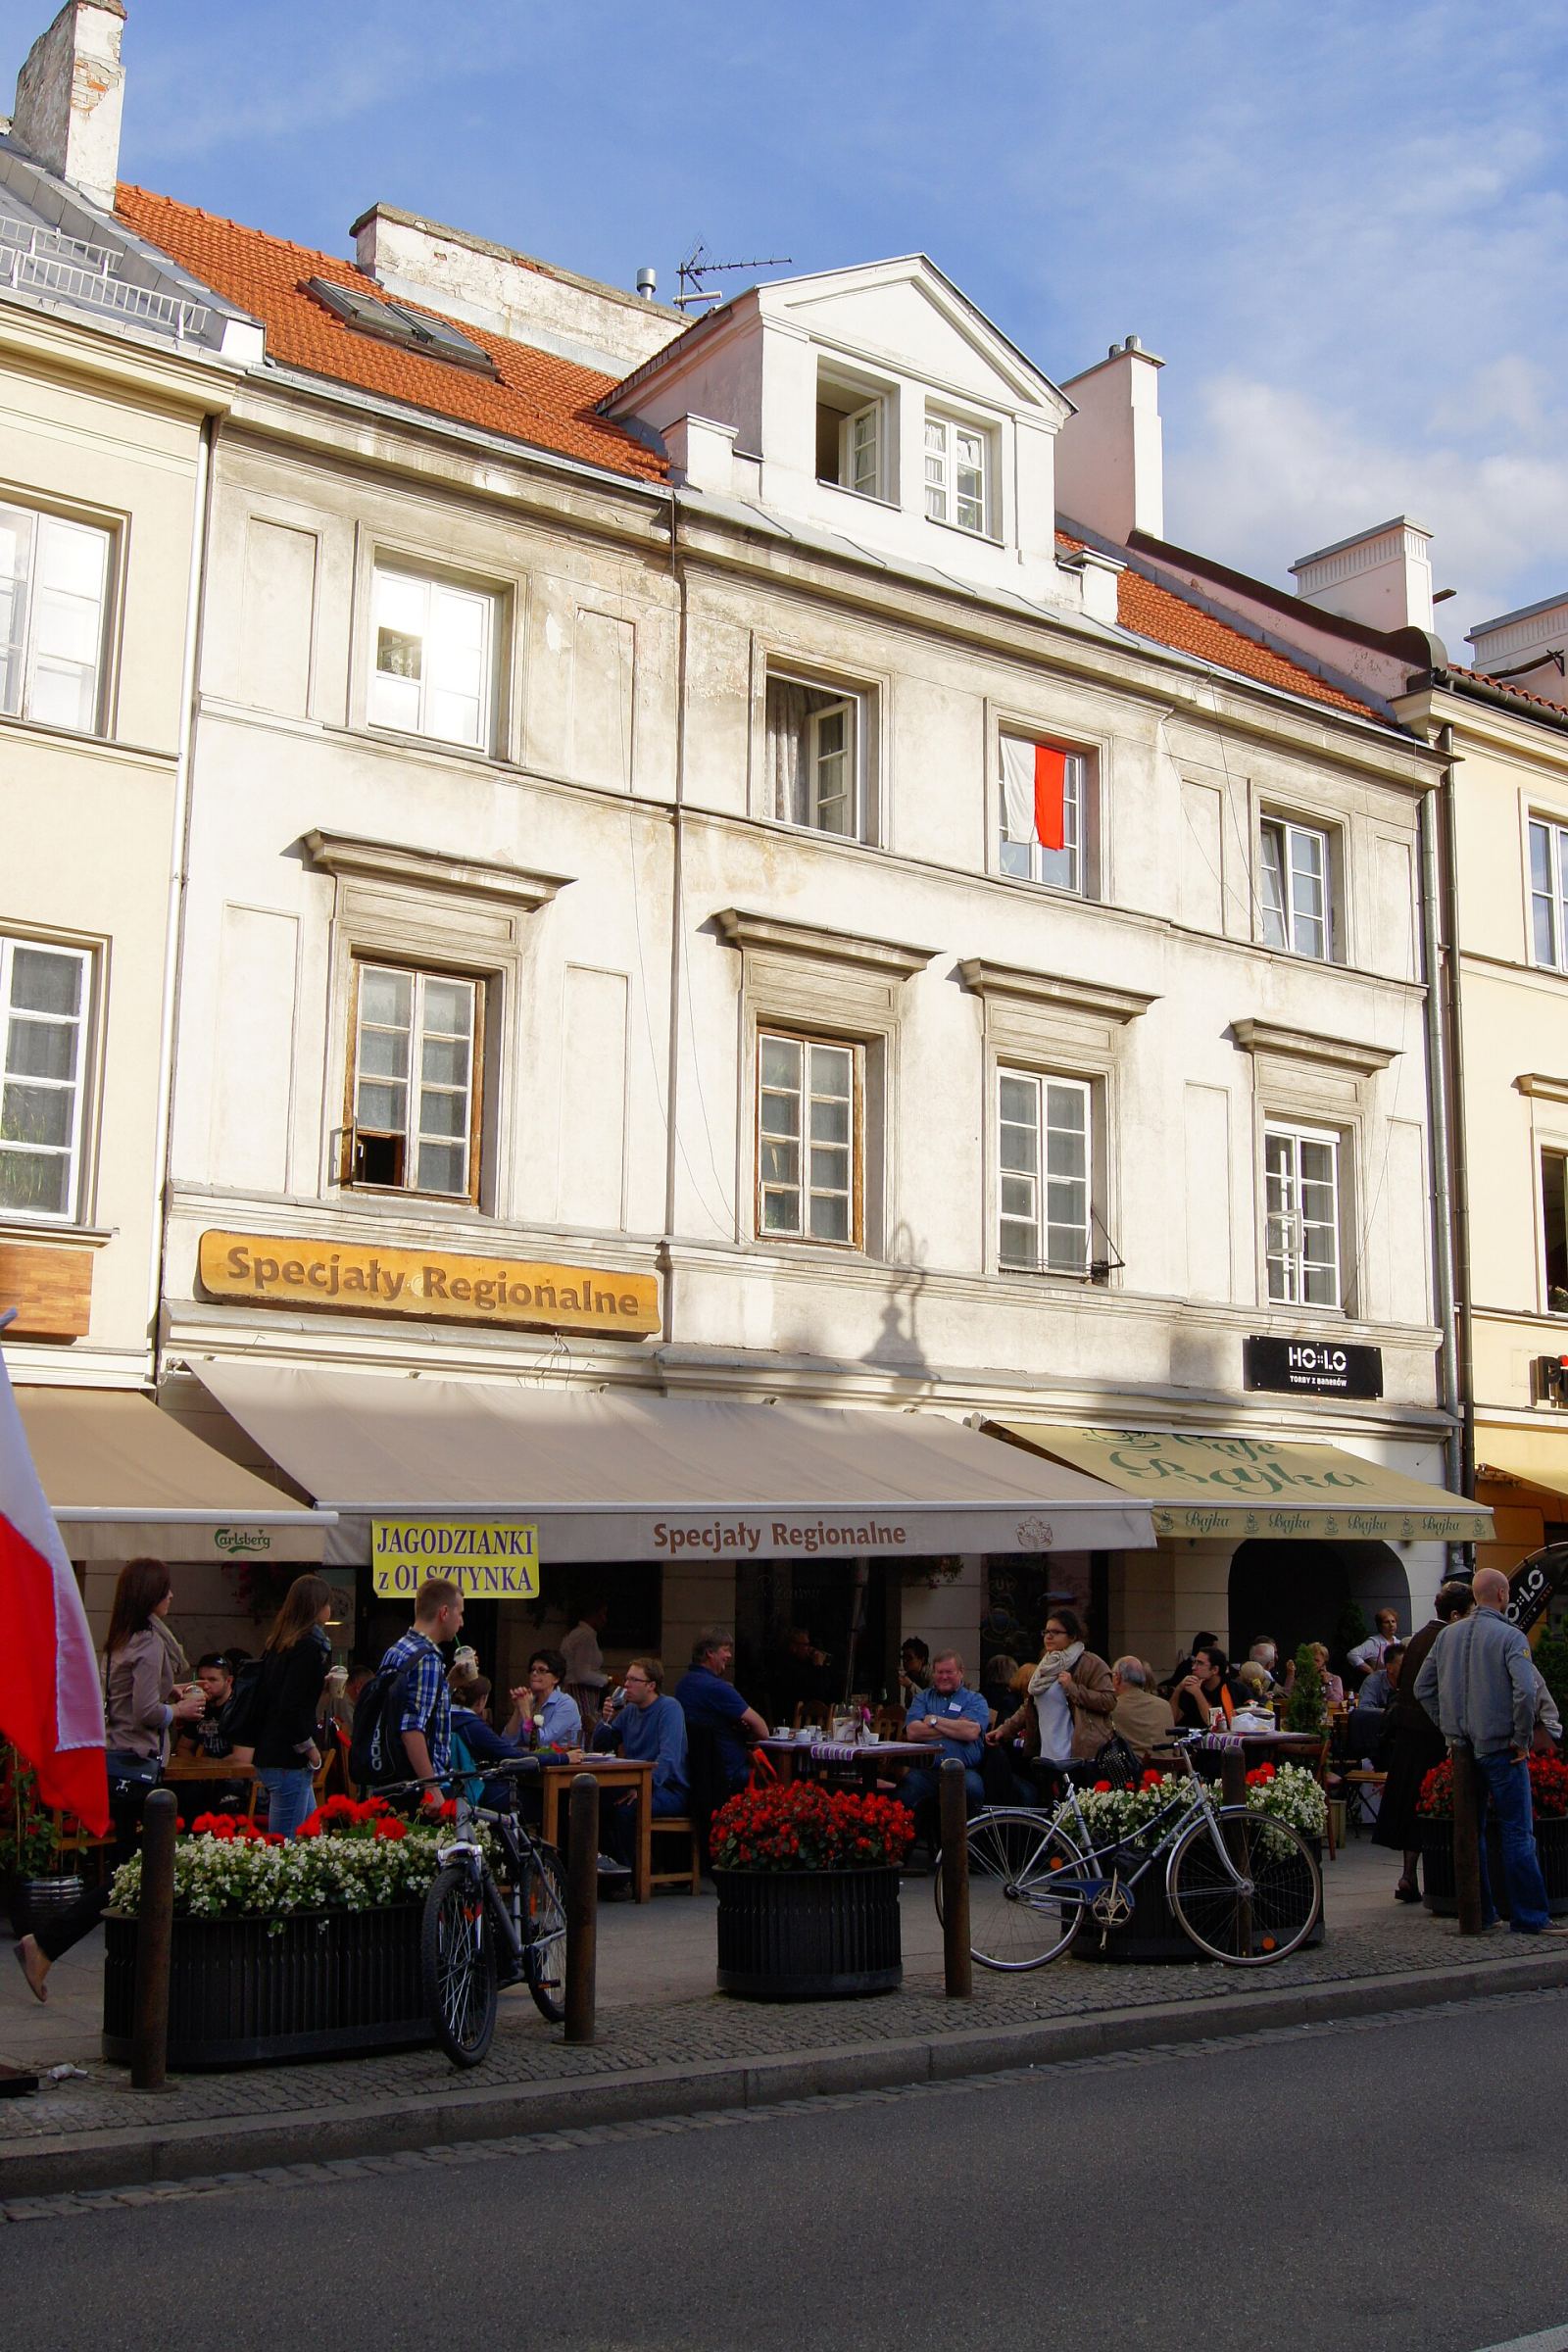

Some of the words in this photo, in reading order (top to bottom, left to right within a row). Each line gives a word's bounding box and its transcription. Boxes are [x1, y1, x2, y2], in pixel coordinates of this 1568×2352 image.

[226, 1247, 405, 1301] Specjały
[421, 1266, 639, 1317] Regionalne
[1289, 1375, 1310, 1384] TORBY
[1109, 1450, 1375, 1495] Bajka
[653, 1522, 761, 1553] Specjały
[771, 1521, 906, 1551] Regionalne
[1185, 1511, 1230, 1534] Bajka
[1268, 1513, 1311, 1535] Bajka
[1348, 1515, 1388, 1536] Bajka
[1420, 1515, 1460, 1537] Bajka
[215, 1528, 270, 1553] Carlsberg
[377, 1527, 533, 1556] JAGODZIANKI
[378, 1571, 389, 1590] z
